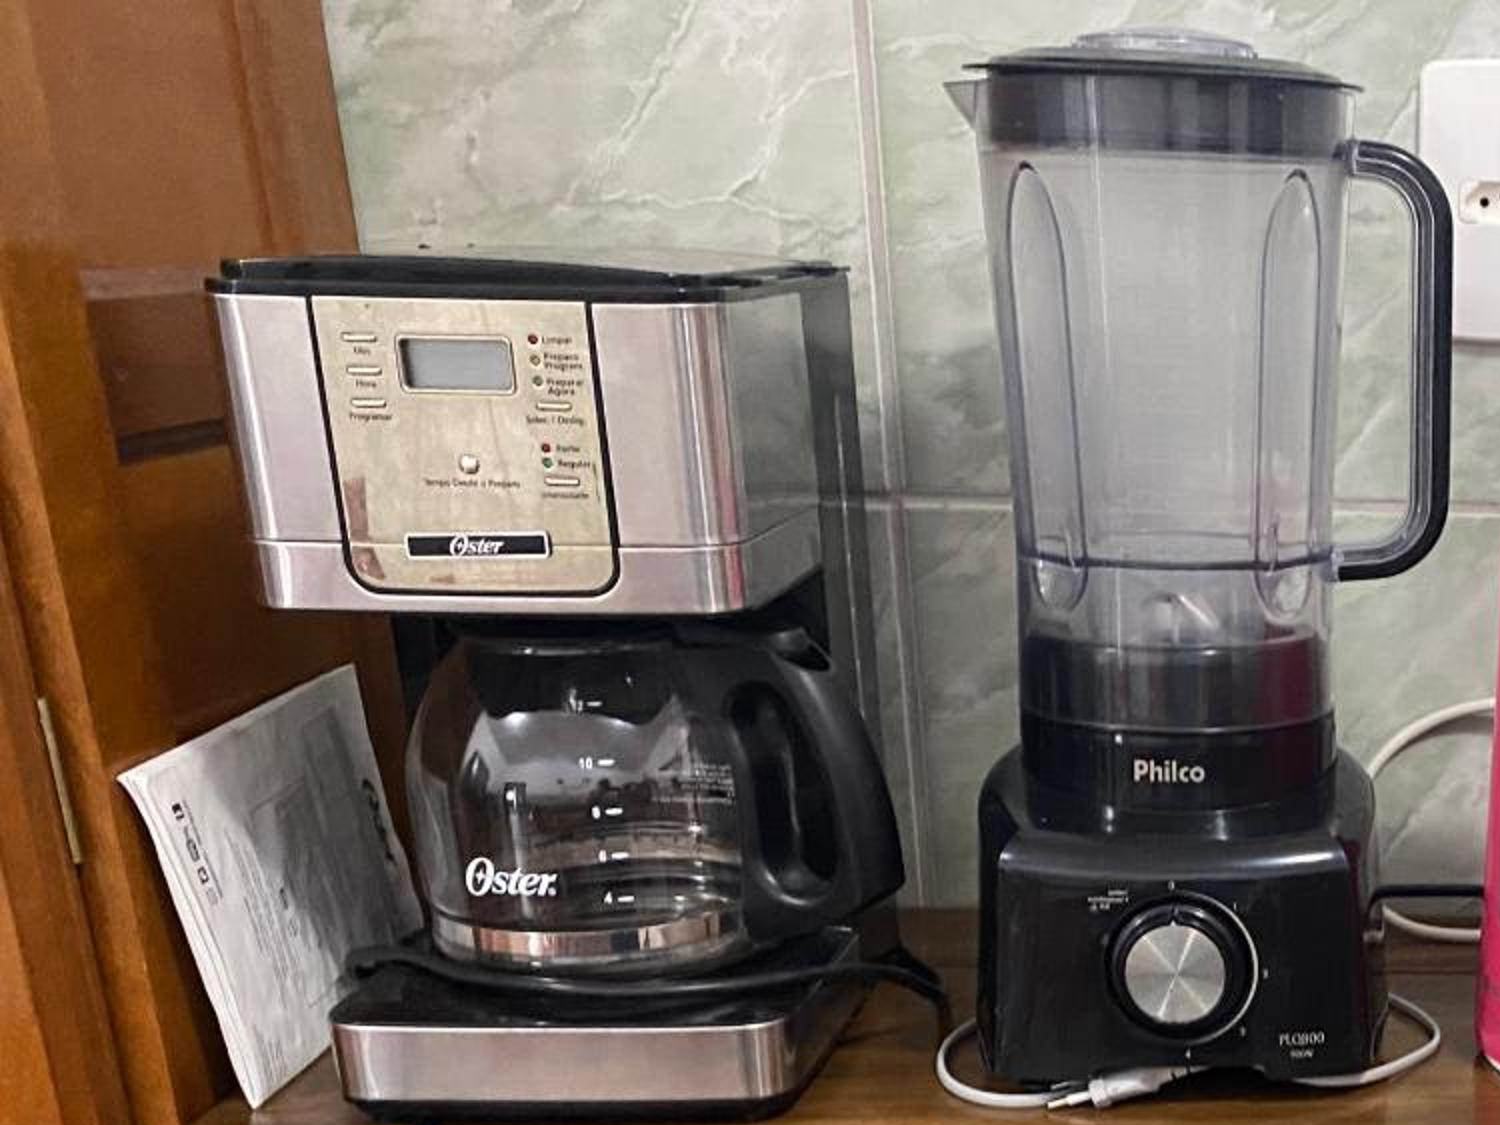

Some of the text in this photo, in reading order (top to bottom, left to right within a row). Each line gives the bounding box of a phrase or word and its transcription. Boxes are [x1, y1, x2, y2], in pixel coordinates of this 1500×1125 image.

[450, 534, 504, 557] Oster
[578, 755, 593, 770] 10
[1133, 758, 1206, 784] Philco
